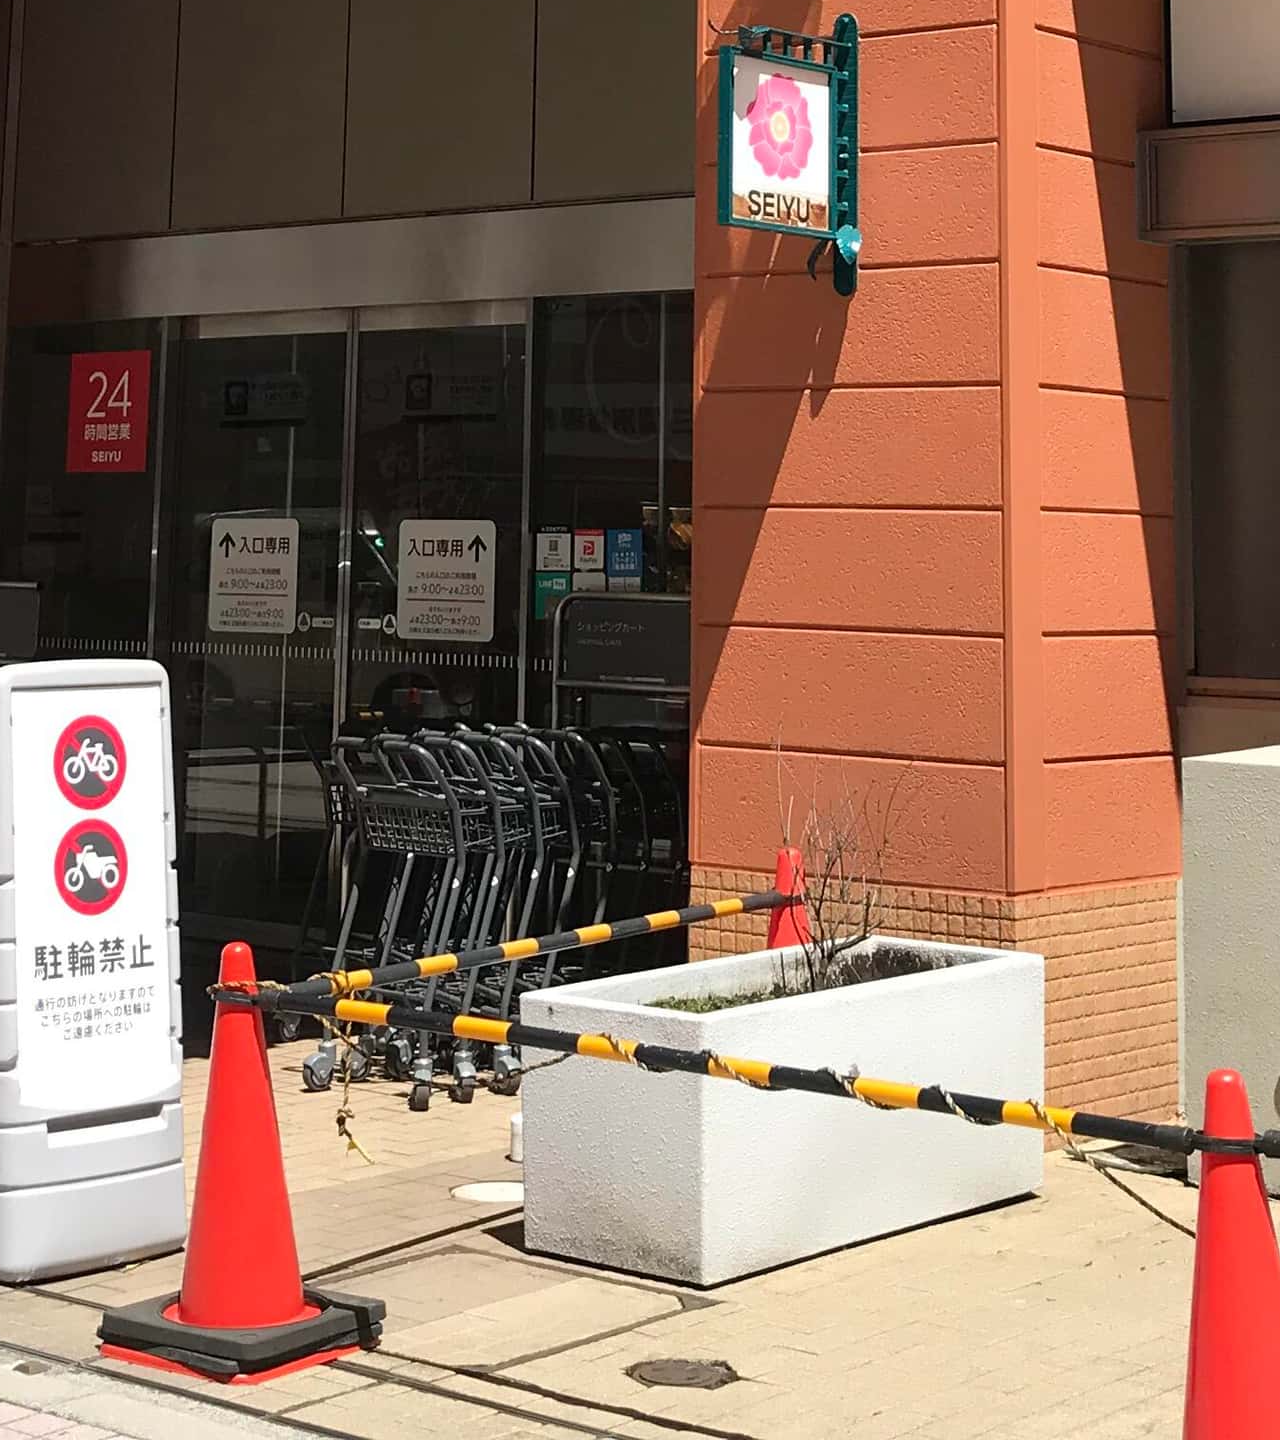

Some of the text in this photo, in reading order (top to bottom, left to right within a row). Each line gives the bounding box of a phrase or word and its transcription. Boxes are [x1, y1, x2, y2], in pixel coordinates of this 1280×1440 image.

[747, 190, 811, 222] SEIYU
[86, 369, 132, 418] 24
[84, 423, 131, 441] 時間営業
[91, 450, 122, 463] SEIYU
[239, 536, 290, 554] 入口専用
[408, 539, 464, 558] 入口専用
[34, 934, 155, 981] 駐輪禁止
[35, 985, 155, 1012] 通行の妨げとなりますので
[40, 1002, 151, 1027] こちらの場所への駐輪は
[64, 1021, 134, 1041] ご遠慮ください
